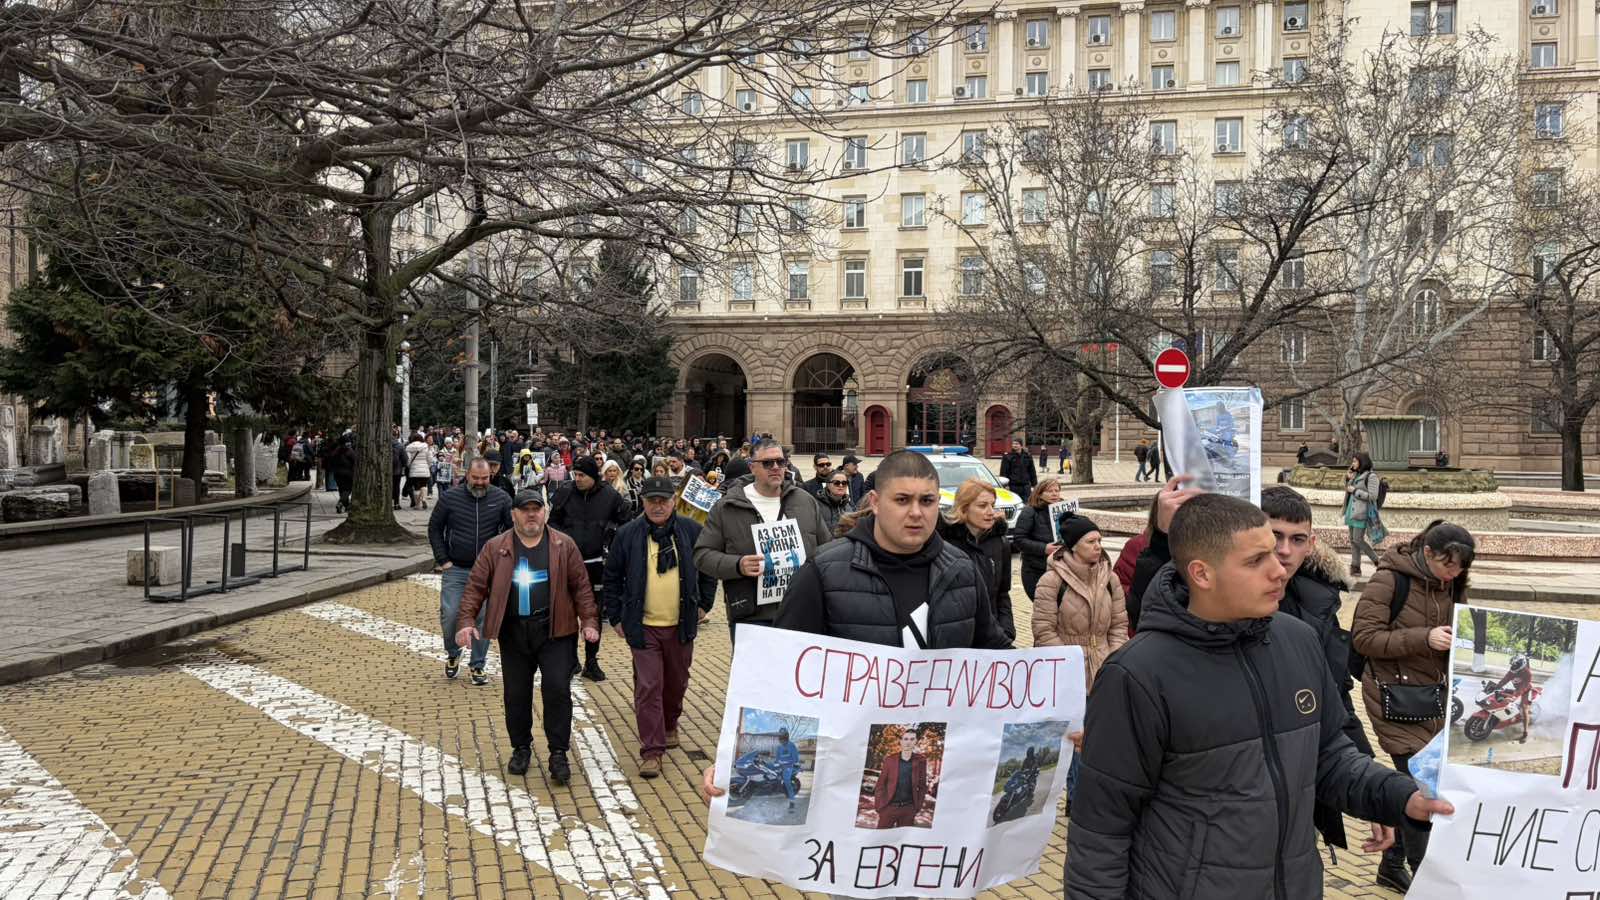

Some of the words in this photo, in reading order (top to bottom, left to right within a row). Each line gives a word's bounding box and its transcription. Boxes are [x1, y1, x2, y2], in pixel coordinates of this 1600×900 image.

[757, 528, 769, 541] АЗ
[772, 525, 796, 539] СЪМ
[760, 537, 799, 554] СИЯНА!
[762, 575, 792, 589] СМЪР
[763, 588, 772, 598] НА
[795, 646, 1066, 709] СПРАВЕДЛИВОСТ
[1562, 722, 1600, 790] П
[1466, 802, 1568, 871] НИЕ
[1575, 809, 1600, 872] С
[798, 838, 835, 884] ЗА
[854, 844, 984, 889] ЕВГЕНИ
